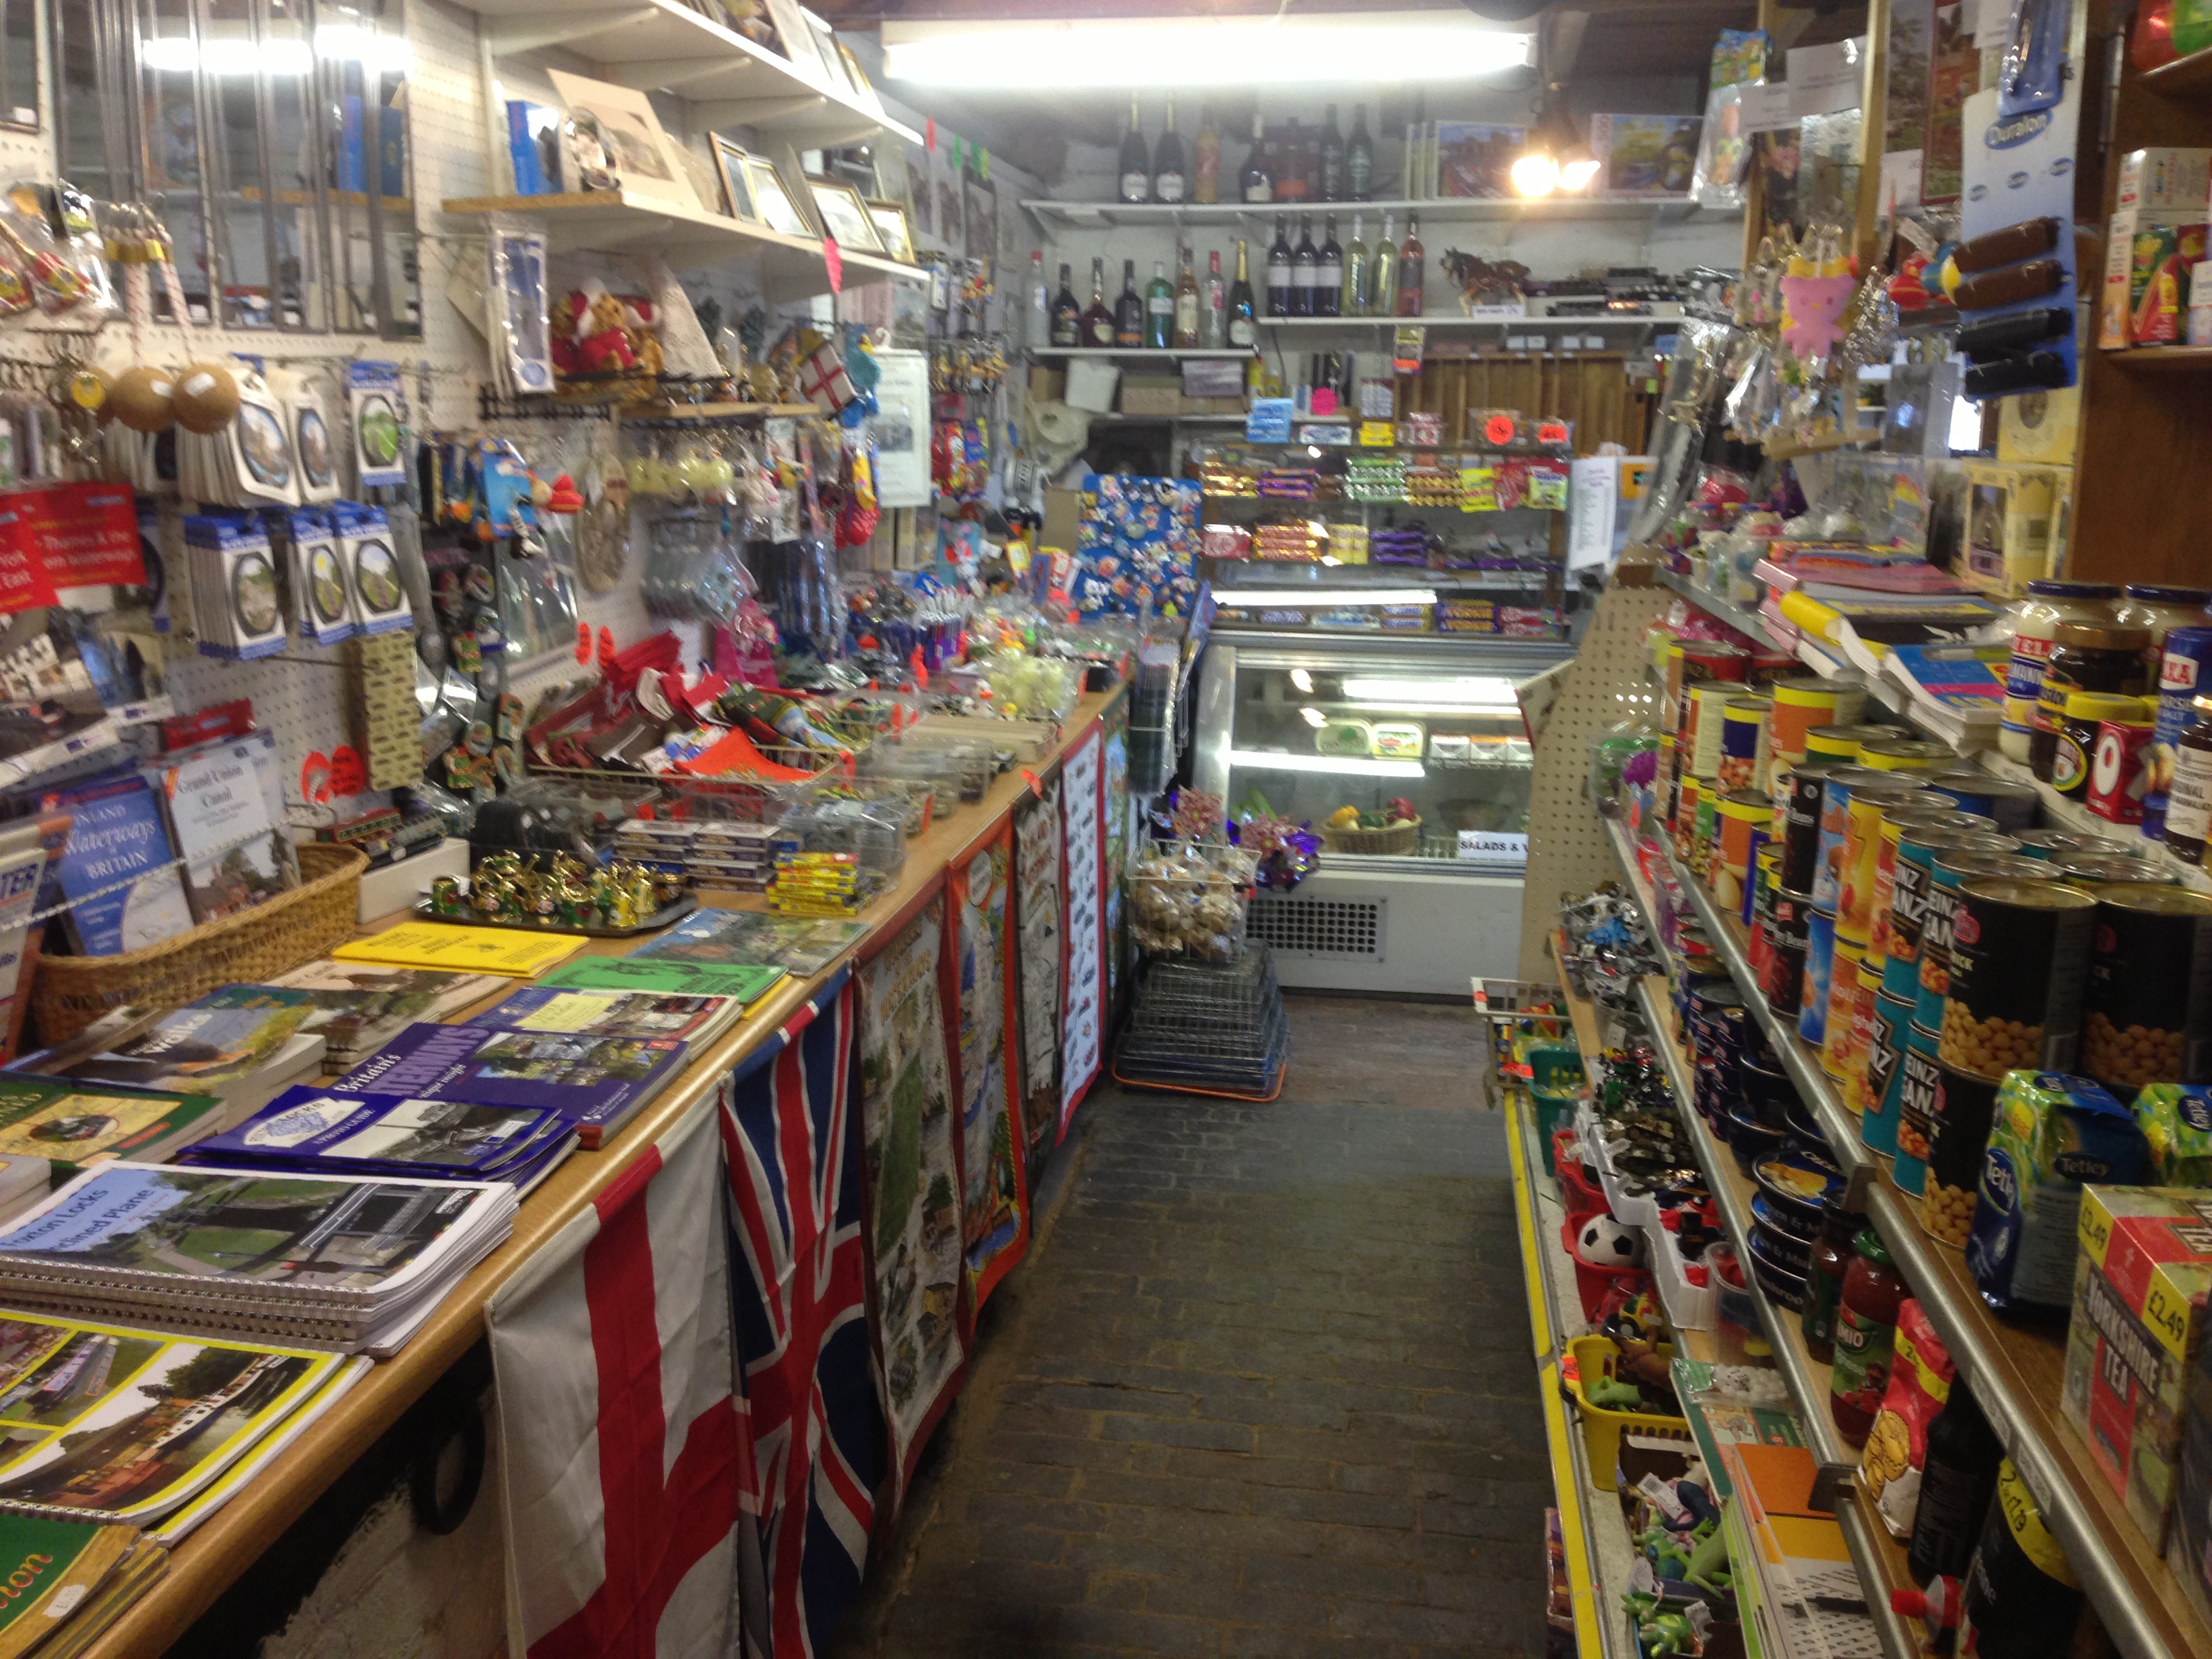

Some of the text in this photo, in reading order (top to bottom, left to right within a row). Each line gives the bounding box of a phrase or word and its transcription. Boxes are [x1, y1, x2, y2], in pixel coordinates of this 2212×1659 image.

[1459, 840, 1519, 853] SALADS &
[85, 849, 148, 880] BRITAIN
[333, 1053, 403, 1094] Britain's
[2060, 1157, 2110, 1178] Tetley
[63, 1188, 110, 1219] Locks
[102, 1188, 156, 1219] Plane
[2087, 1268, 2159, 1396] YORKSHIRE
[2147, 1290, 2186, 1343] £2.49
[2104, 1341, 2129, 1402] TEA
